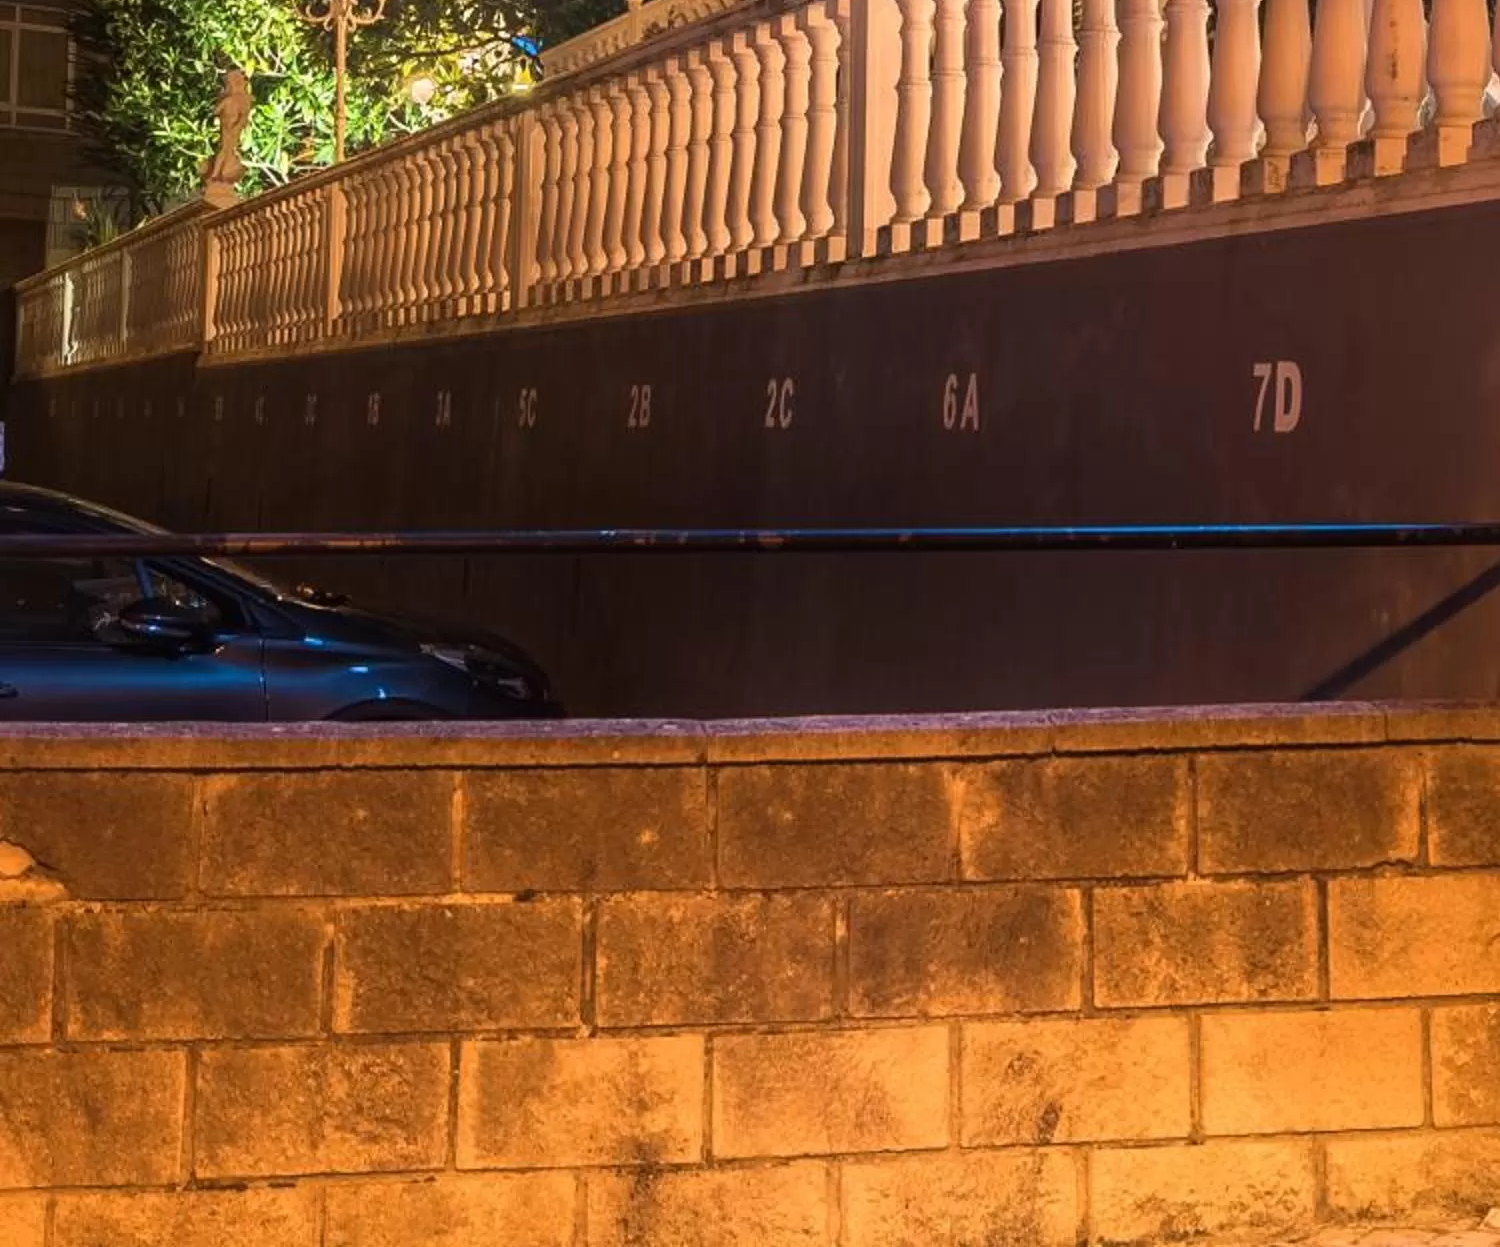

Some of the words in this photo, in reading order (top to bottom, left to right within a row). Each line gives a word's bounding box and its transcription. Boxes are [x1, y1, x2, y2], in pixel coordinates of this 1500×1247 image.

[518, 387, 538, 429] 5C
[627, 384, 651, 428] 2B
[765, 377, 794, 429] 2C
[942, 372, 980, 431] 6A
[1252, 360, 1301, 433] 7D
